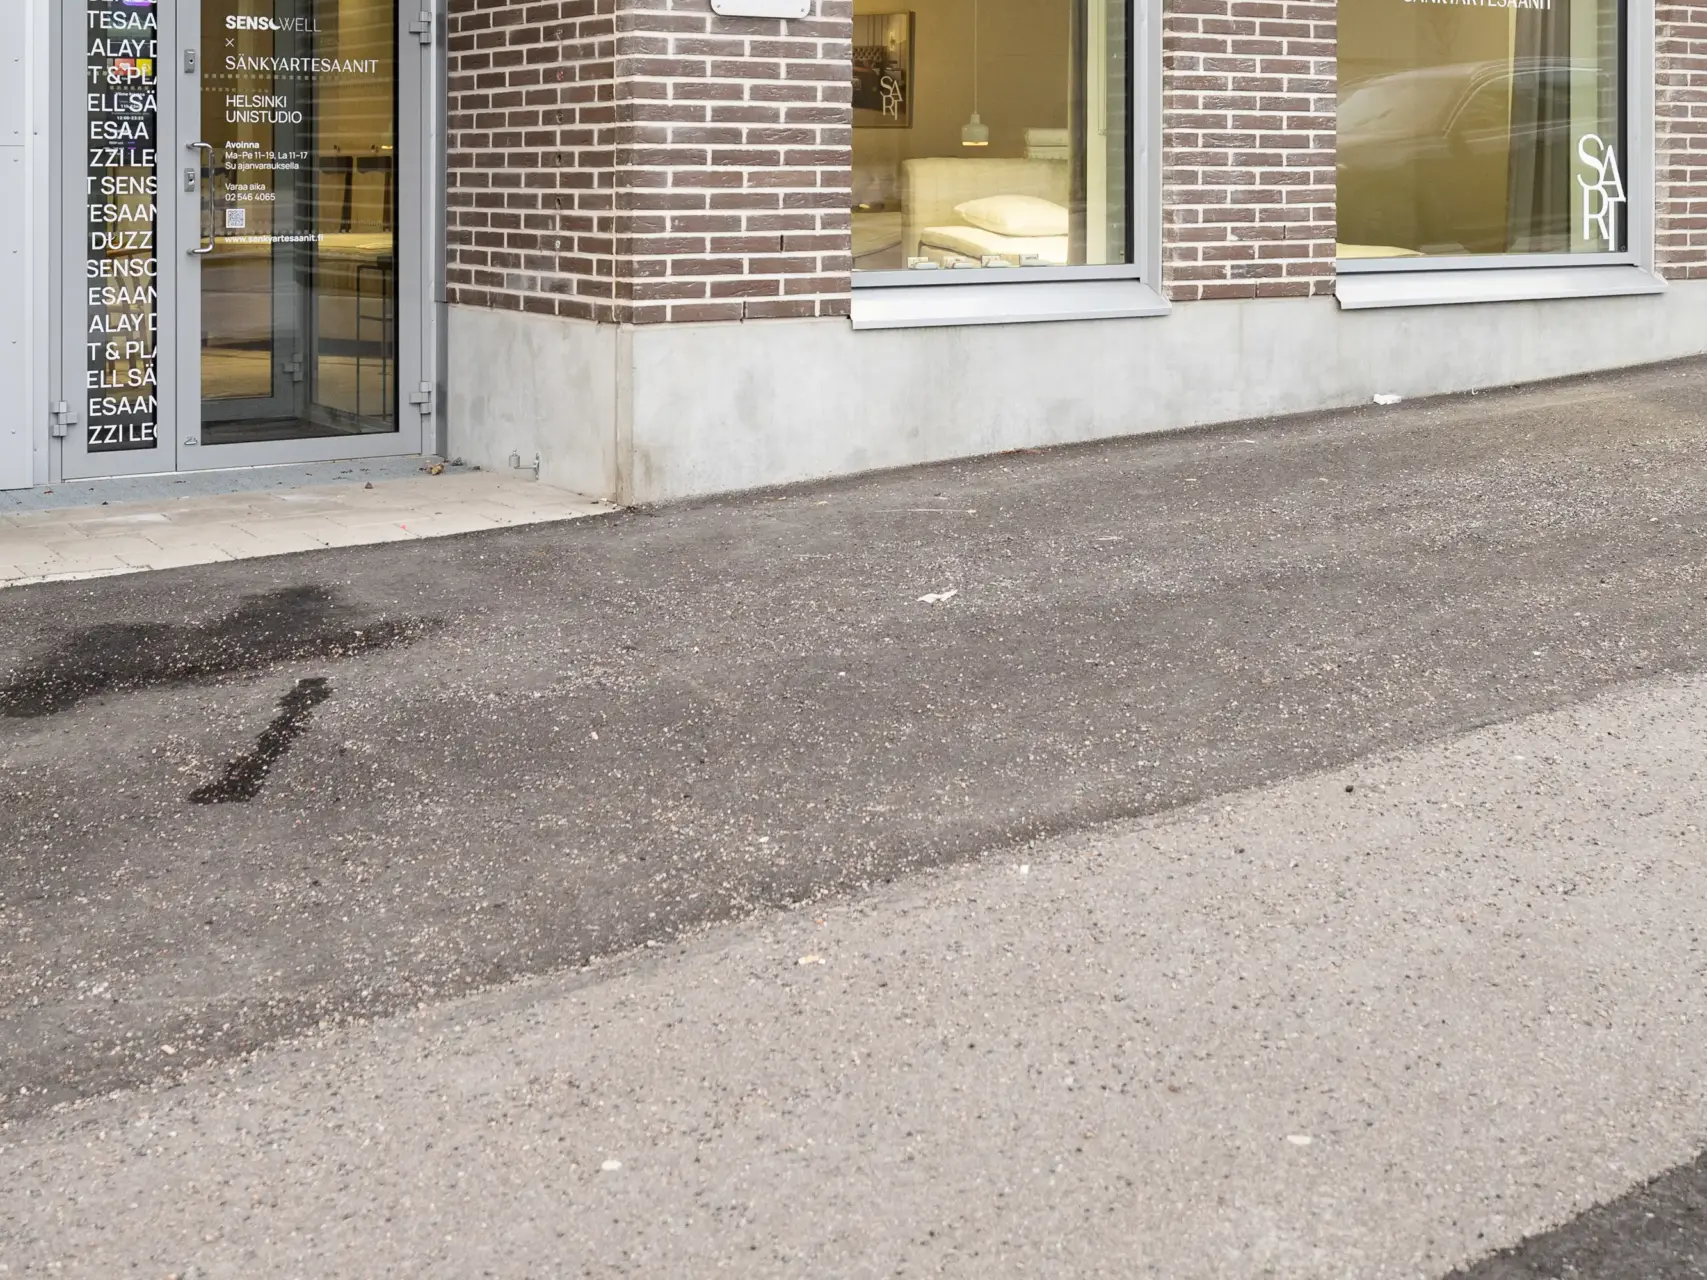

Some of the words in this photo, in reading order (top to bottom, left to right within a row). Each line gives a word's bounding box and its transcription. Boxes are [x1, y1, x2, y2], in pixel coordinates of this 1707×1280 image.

[226, 54, 378, 73] SÄNKYARTESAANIT
[88, 66, 102, 84] T
[107, 66, 122, 84] &
[88, 93, 125, 112] ELL
[226, 94, 286, 108] HELSINKI
[226, 110, 302, 124] UNISTUDIO
[90, 121, 149, 140] ESAA
[90, 148, 124, 166] ZZI
[278, 152, 288, 160] La
[225, 162, 236, 170] Su
[238, 162, 299, 172] ajanvarauksella
[226, 193, 236, 201] 02
[238, 193, 253, 201] 546
[254, 193, 276, 201] 4065
[92, 231, 152, 250] DUZZ
[89, 314, 142, 333] ALAY
[106, 341, 120, 360] &
[88, 370, 124, 388] ELL
[88, 426, 122, 444] ZZI
